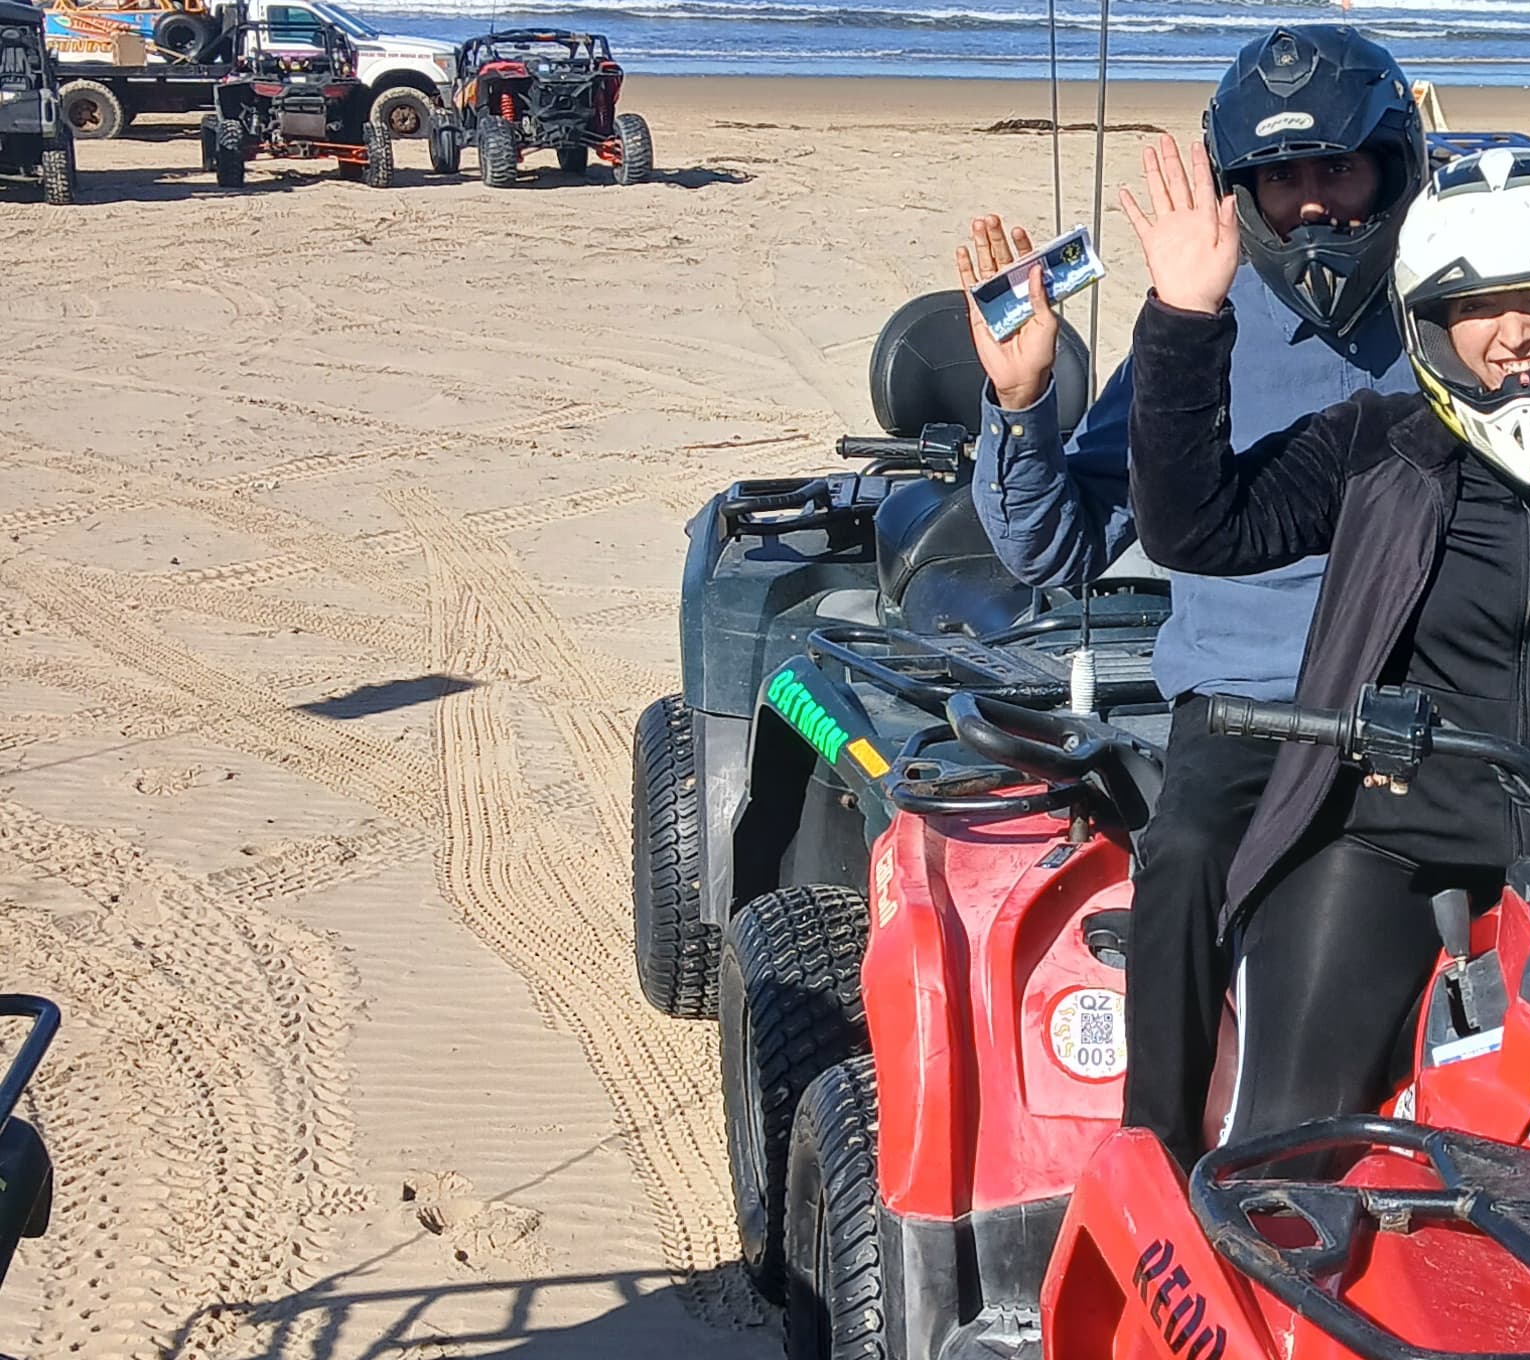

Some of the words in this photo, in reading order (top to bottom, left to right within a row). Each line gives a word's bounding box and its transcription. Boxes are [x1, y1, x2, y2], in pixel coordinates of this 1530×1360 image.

[767, 668, 849, 765] BATMAN
[1079, 995, 1112, 1011] QZ
[1077, 1047, 1115, 1066] 003
